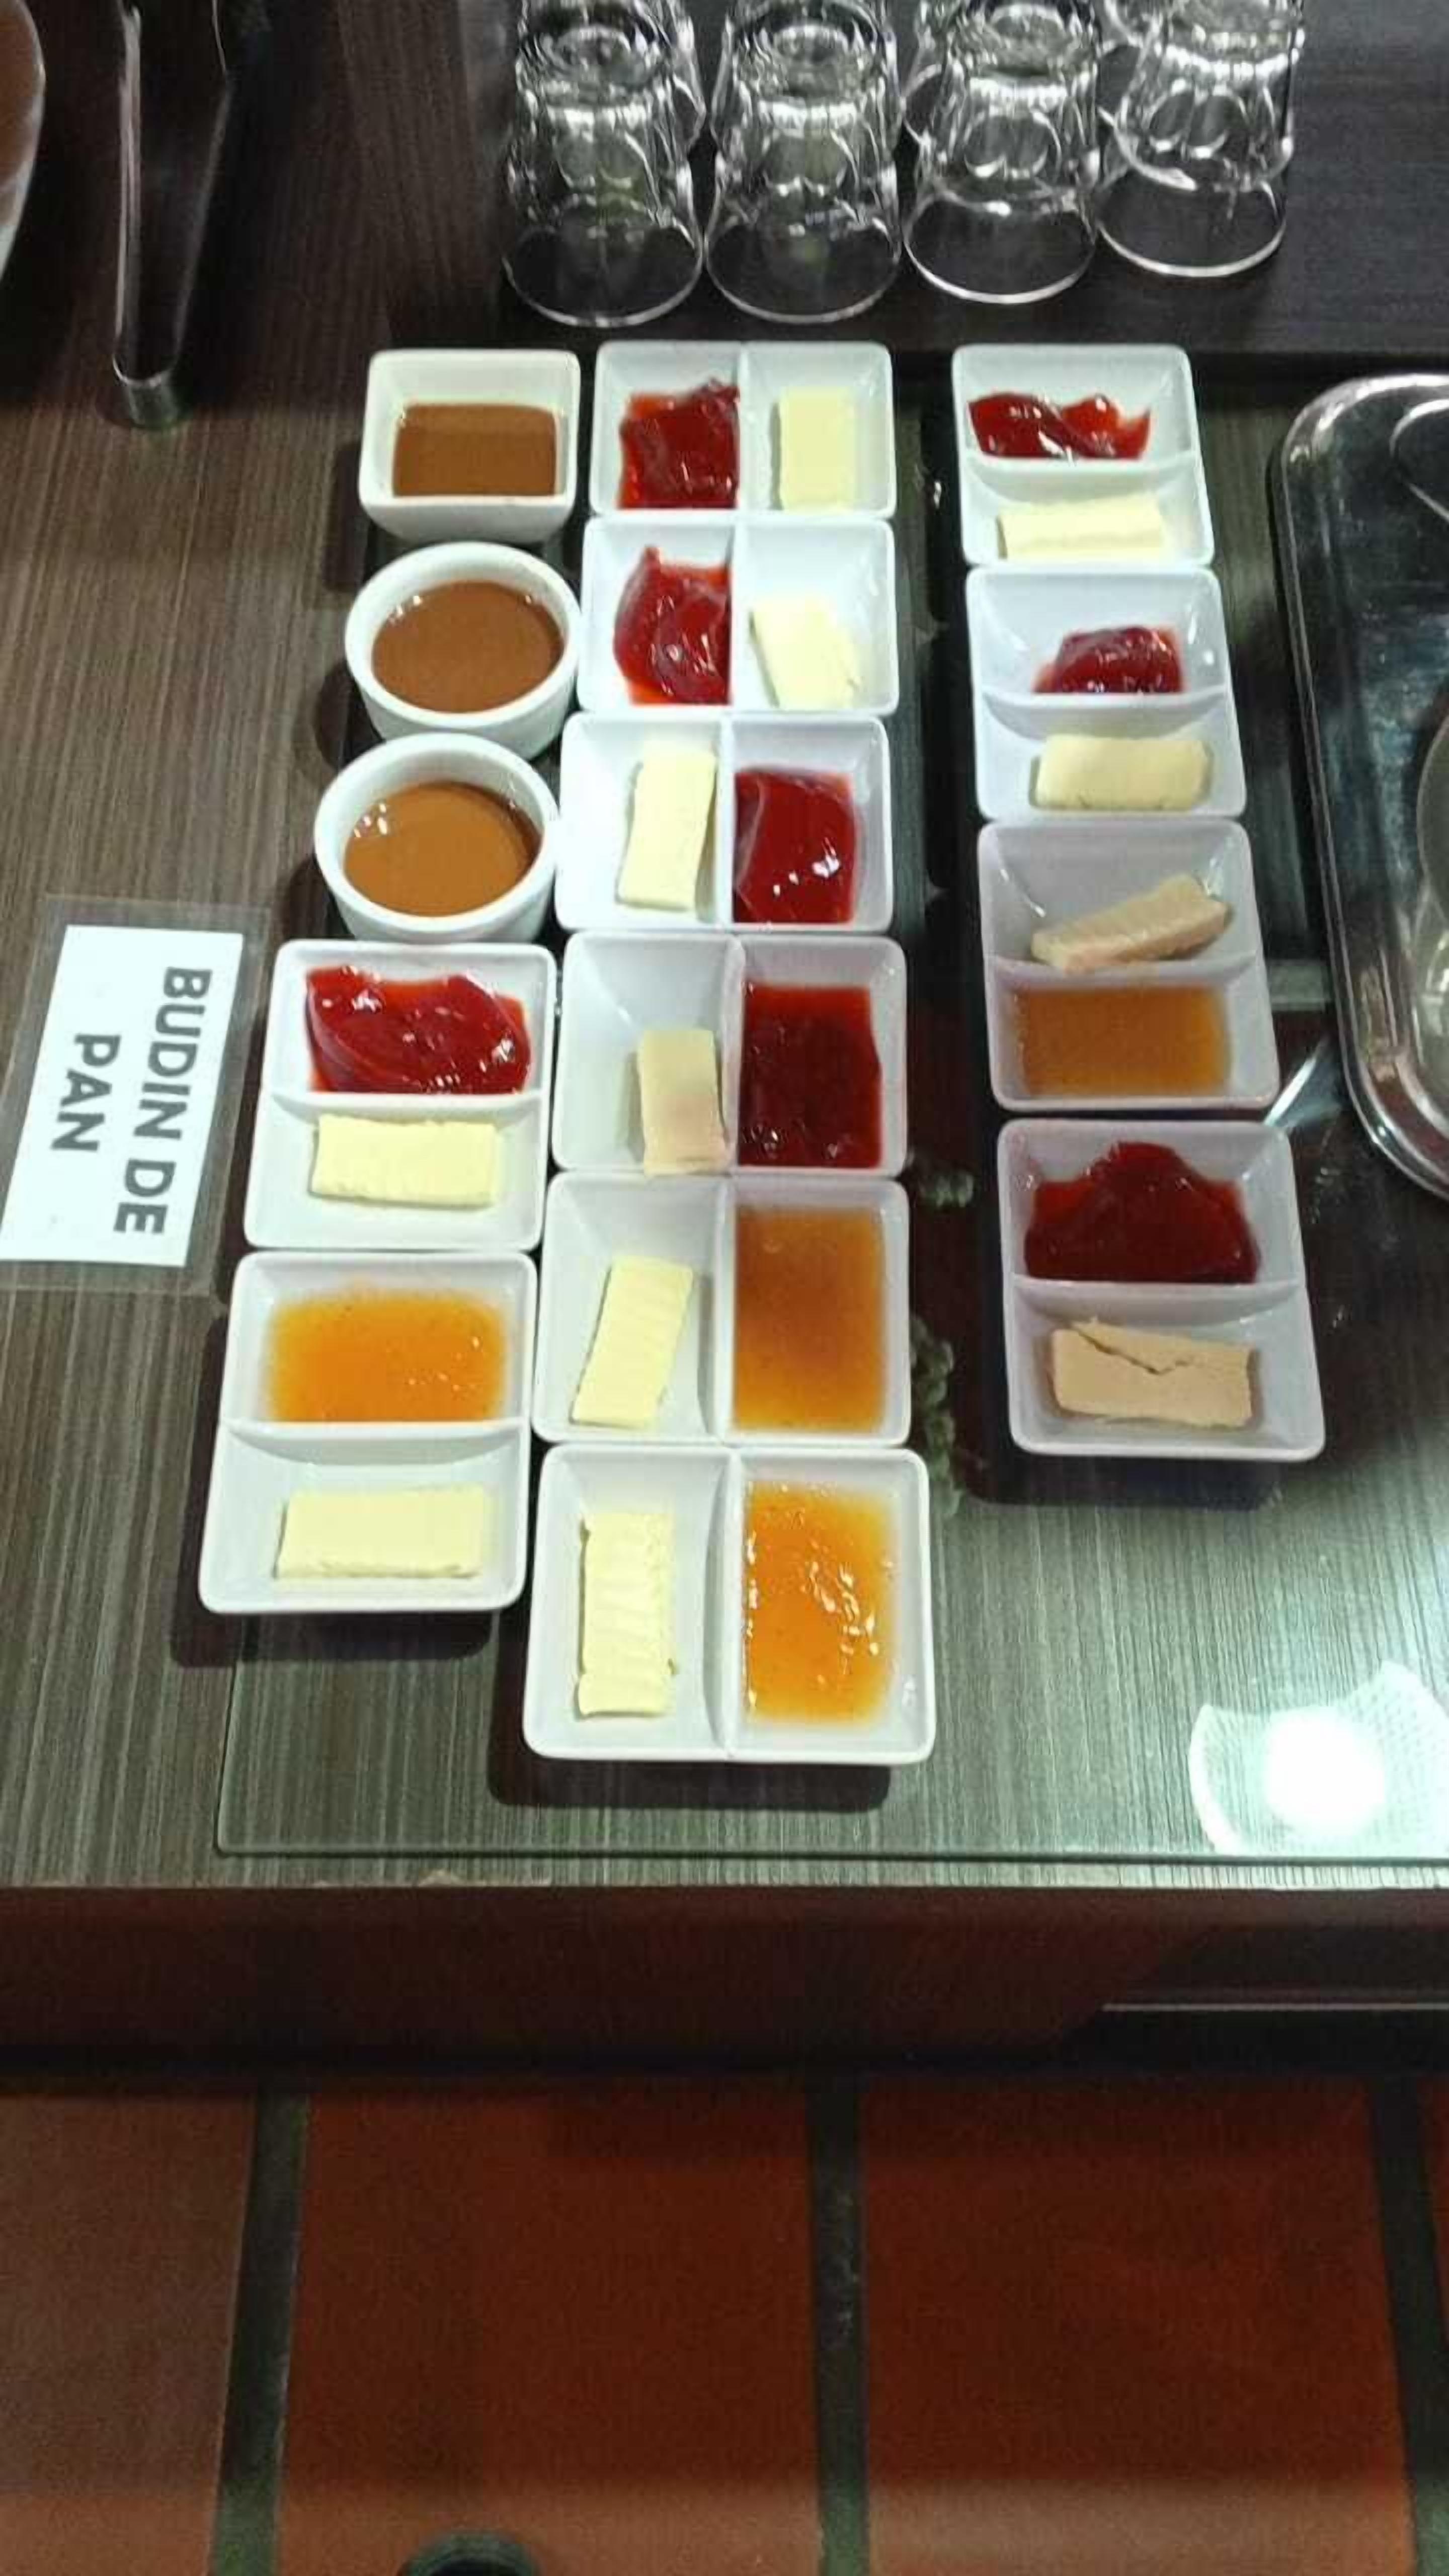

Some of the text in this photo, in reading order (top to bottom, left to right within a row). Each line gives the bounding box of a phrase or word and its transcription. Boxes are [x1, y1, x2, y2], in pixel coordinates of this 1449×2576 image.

[51, 1033, 121, 1152] PAN
[113, 967, 213, 1234] BUDIN DE
